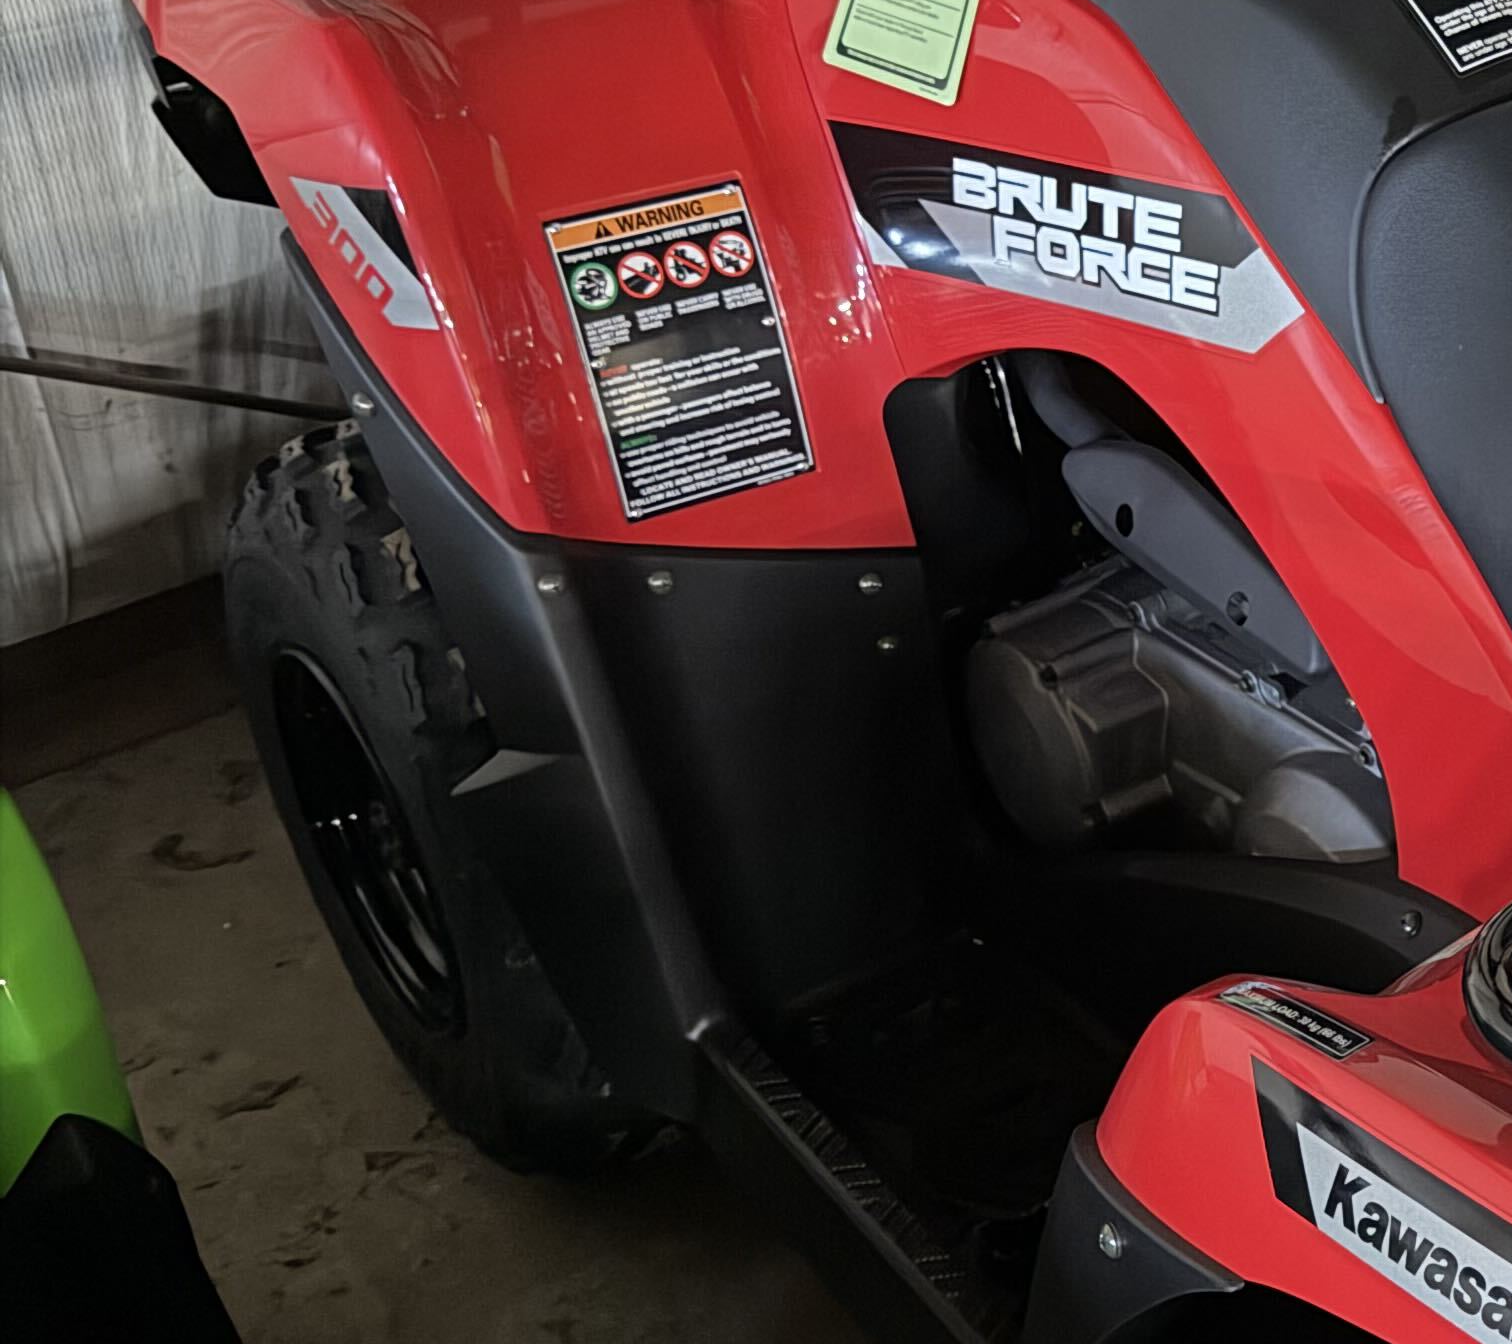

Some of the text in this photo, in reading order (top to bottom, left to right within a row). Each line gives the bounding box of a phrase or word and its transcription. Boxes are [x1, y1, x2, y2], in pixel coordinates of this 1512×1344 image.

[615, 200, 705, 234] WARNING
[951, 156, 1183, 253] BRUTE
[992, 214, 1220, 314] FORCE
